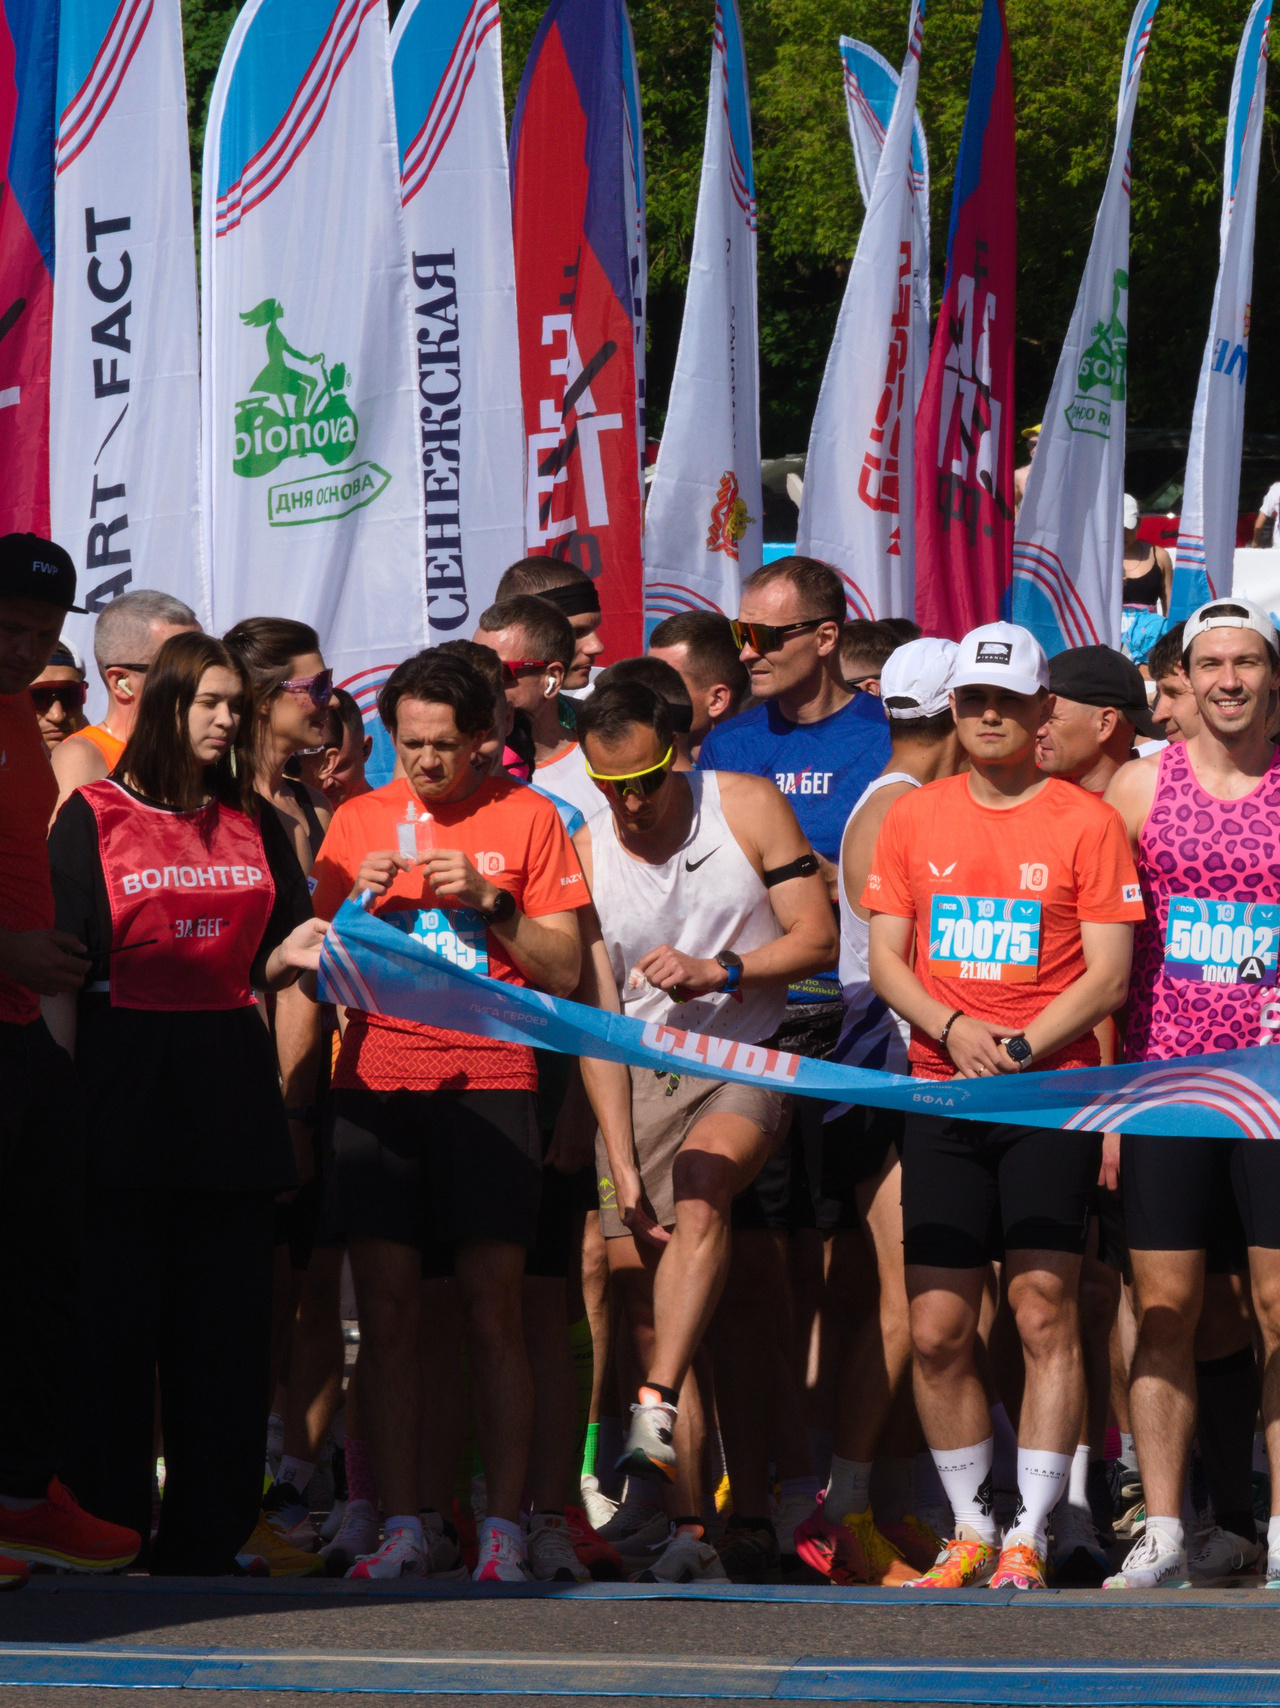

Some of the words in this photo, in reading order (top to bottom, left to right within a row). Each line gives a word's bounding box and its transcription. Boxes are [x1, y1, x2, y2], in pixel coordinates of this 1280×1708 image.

[85, 207, 132, 399] FACT
[412, 248, 469, 631] СЕНЕЖСКАЯ
[275, 490, 313, 514] ДНЯ
[316, 474, 375, 505] ОСНОВА
[32, 560, 59, 576] FWP
[775, 772, 797, 794] ЗА
[801, 772, 833, 795] БЕГ
[474, 851, 506, 876] 10
[122, 866, 262, 895] ВОЛОНТЕР
[1018, 862, 1049, 891] 10
[421, 911, 439, 930] 10
[976, 900, 995, 918] 10
[1216, 904, 1235, 922] 10
[175, 919, 193, 938] ЗА
[196, 917, 223, 937] БЕГ
[937, 918, 1031, 962] 70075
[1171, 919, 1273, 966] 50002
[469, 1003, 500, 1016] ЛИГА
[503, 1010, 548, 1026] ГЕРОЕВ
[912, 1093, 955, 1107] ВФЛА
